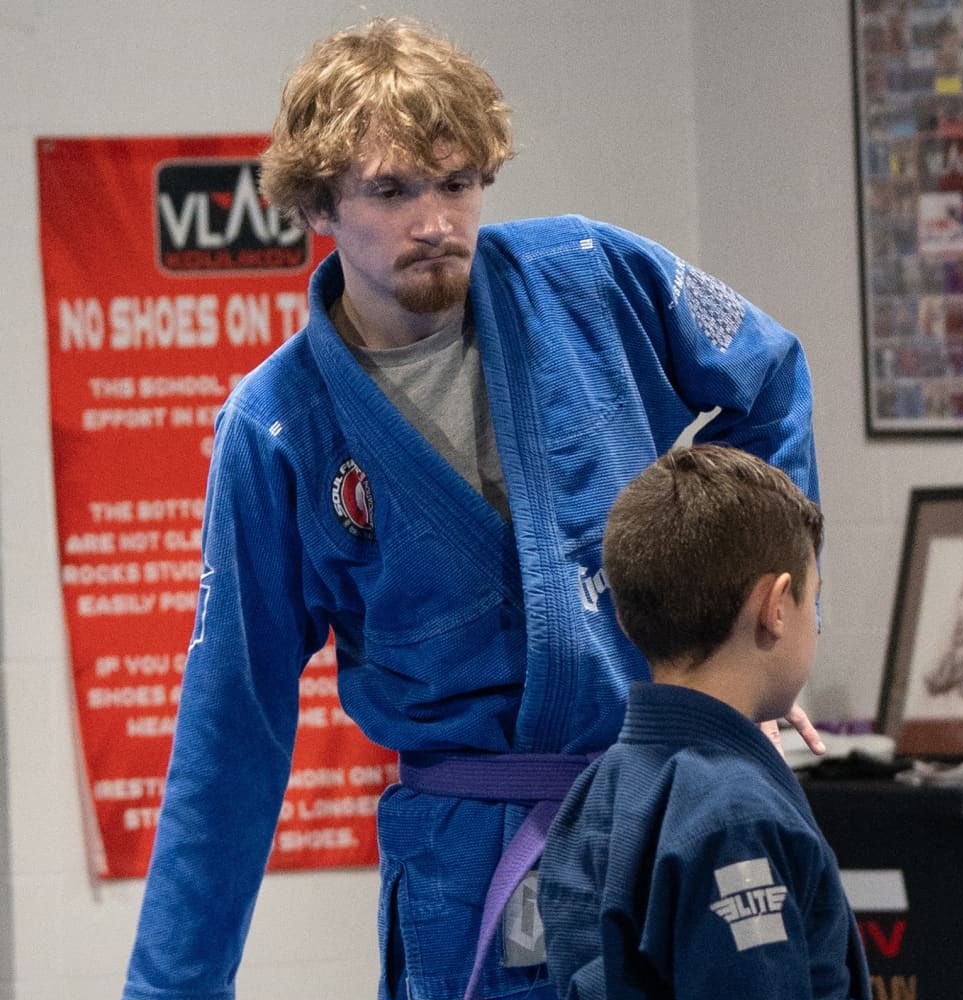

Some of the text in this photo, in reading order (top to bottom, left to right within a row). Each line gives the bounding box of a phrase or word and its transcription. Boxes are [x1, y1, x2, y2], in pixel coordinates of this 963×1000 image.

[59, 296, 105, 351] NO
[110, 293, 219, 351] SHOES
[226, 292, 272, 345] ON
[88, 377, 134, 399] THIS
[82, 407, 167, 431] EFFORT
[170, 407, 194, 428] IN
[332, 476, 349, 519] SOUL
[89, 499, 204, 523] THE BOTTO
[65, 532, 115, 555] ARE
[119, 531, 160, 553] NOT
[62, 562, 140, 585] ROCKS
[77, 594, 156, 616] EASILY
[95, 656, 120, 677] IF
[124, 654, 170, 676] YOU
[87, 685, 166, 709] SHOES
[709, 886, 788, 923] ELITE
